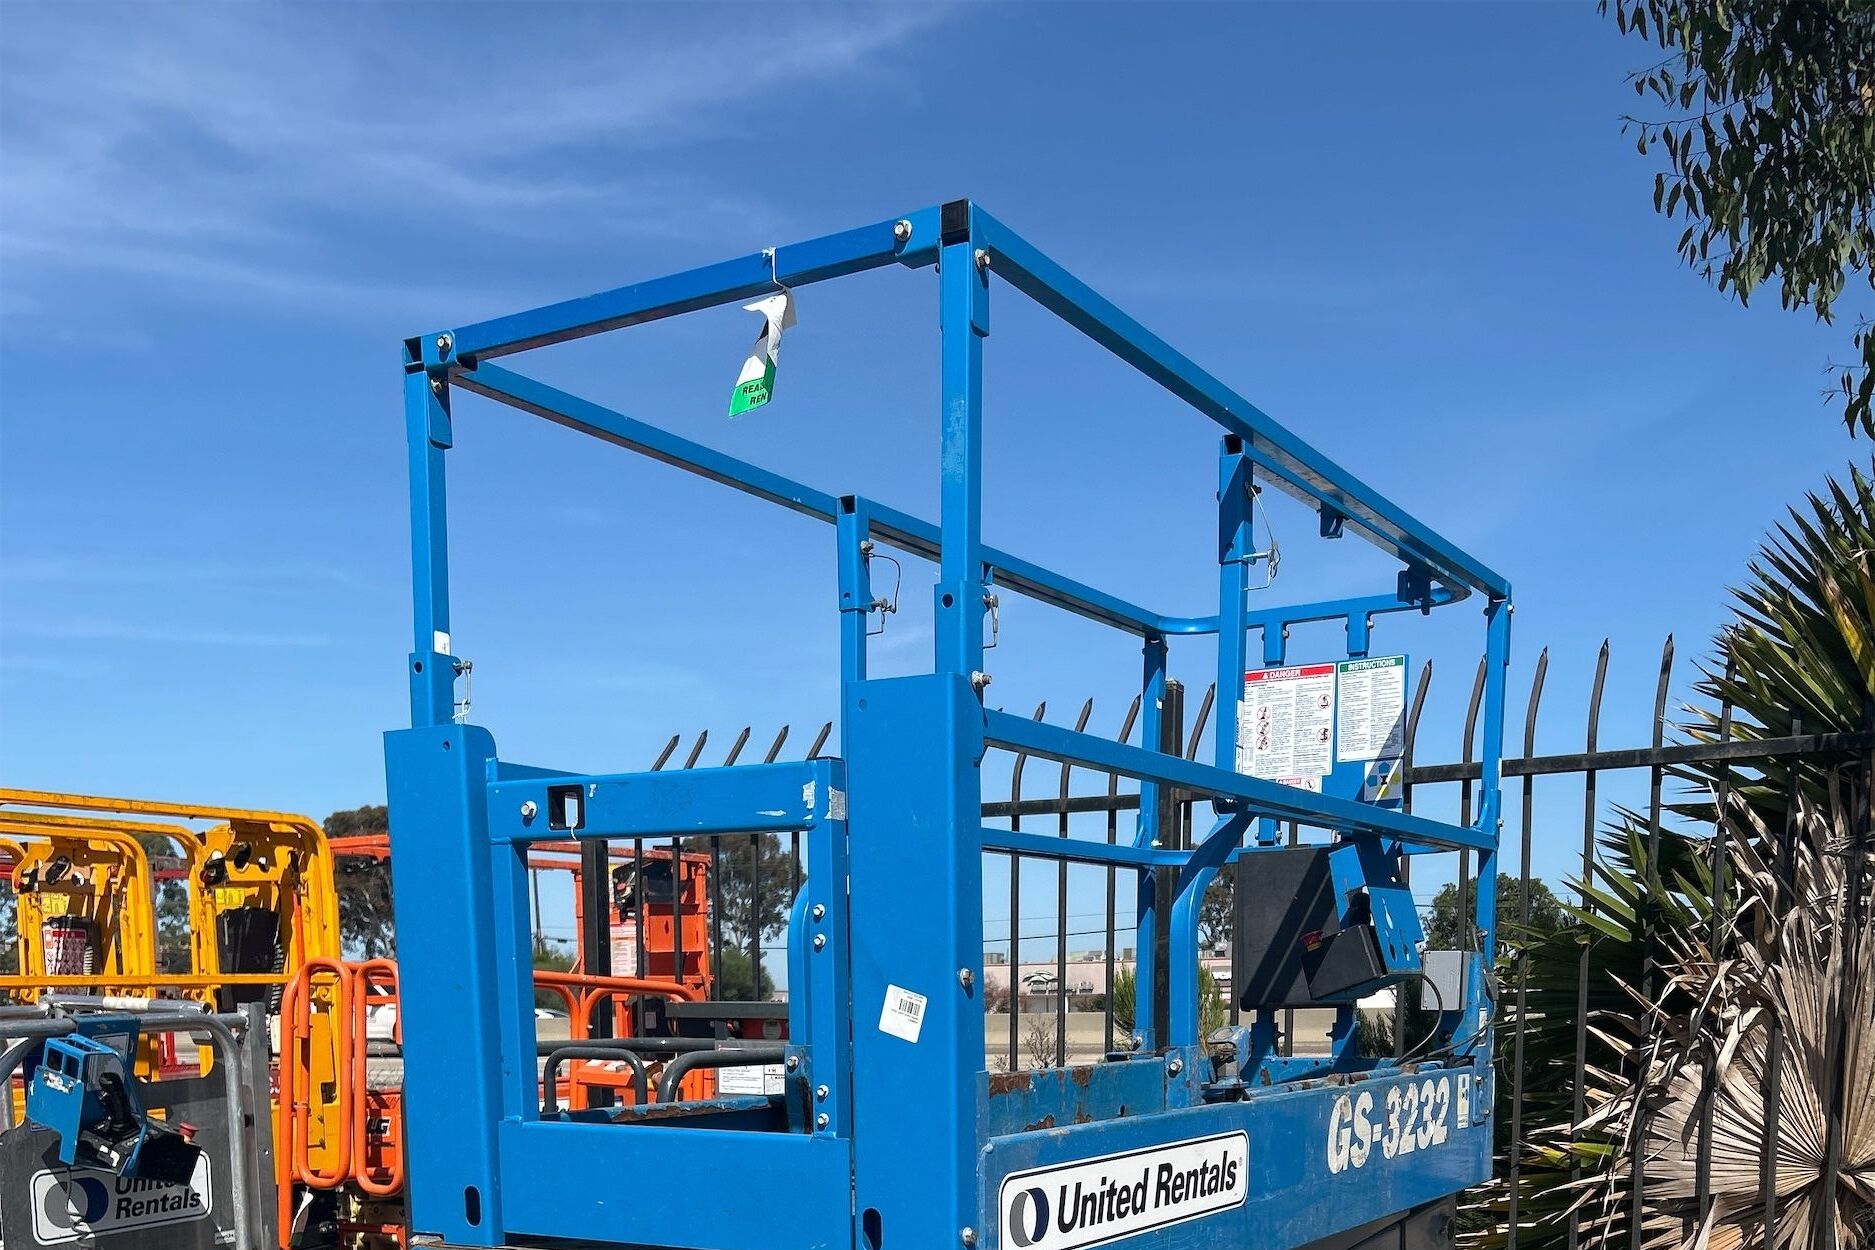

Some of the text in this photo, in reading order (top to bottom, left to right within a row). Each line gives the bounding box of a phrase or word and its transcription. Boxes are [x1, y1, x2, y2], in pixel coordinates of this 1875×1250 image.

[1270, 669, 1300, 680] DANGER
[1348, 658, 1395, 671] INSTRUCTIONS
[1328, 1076, 1450, 1175] GS-3232
[115, 1188, 201, 1220] Rentals
[1058, 1151, 1238, 1234] United Rentals
